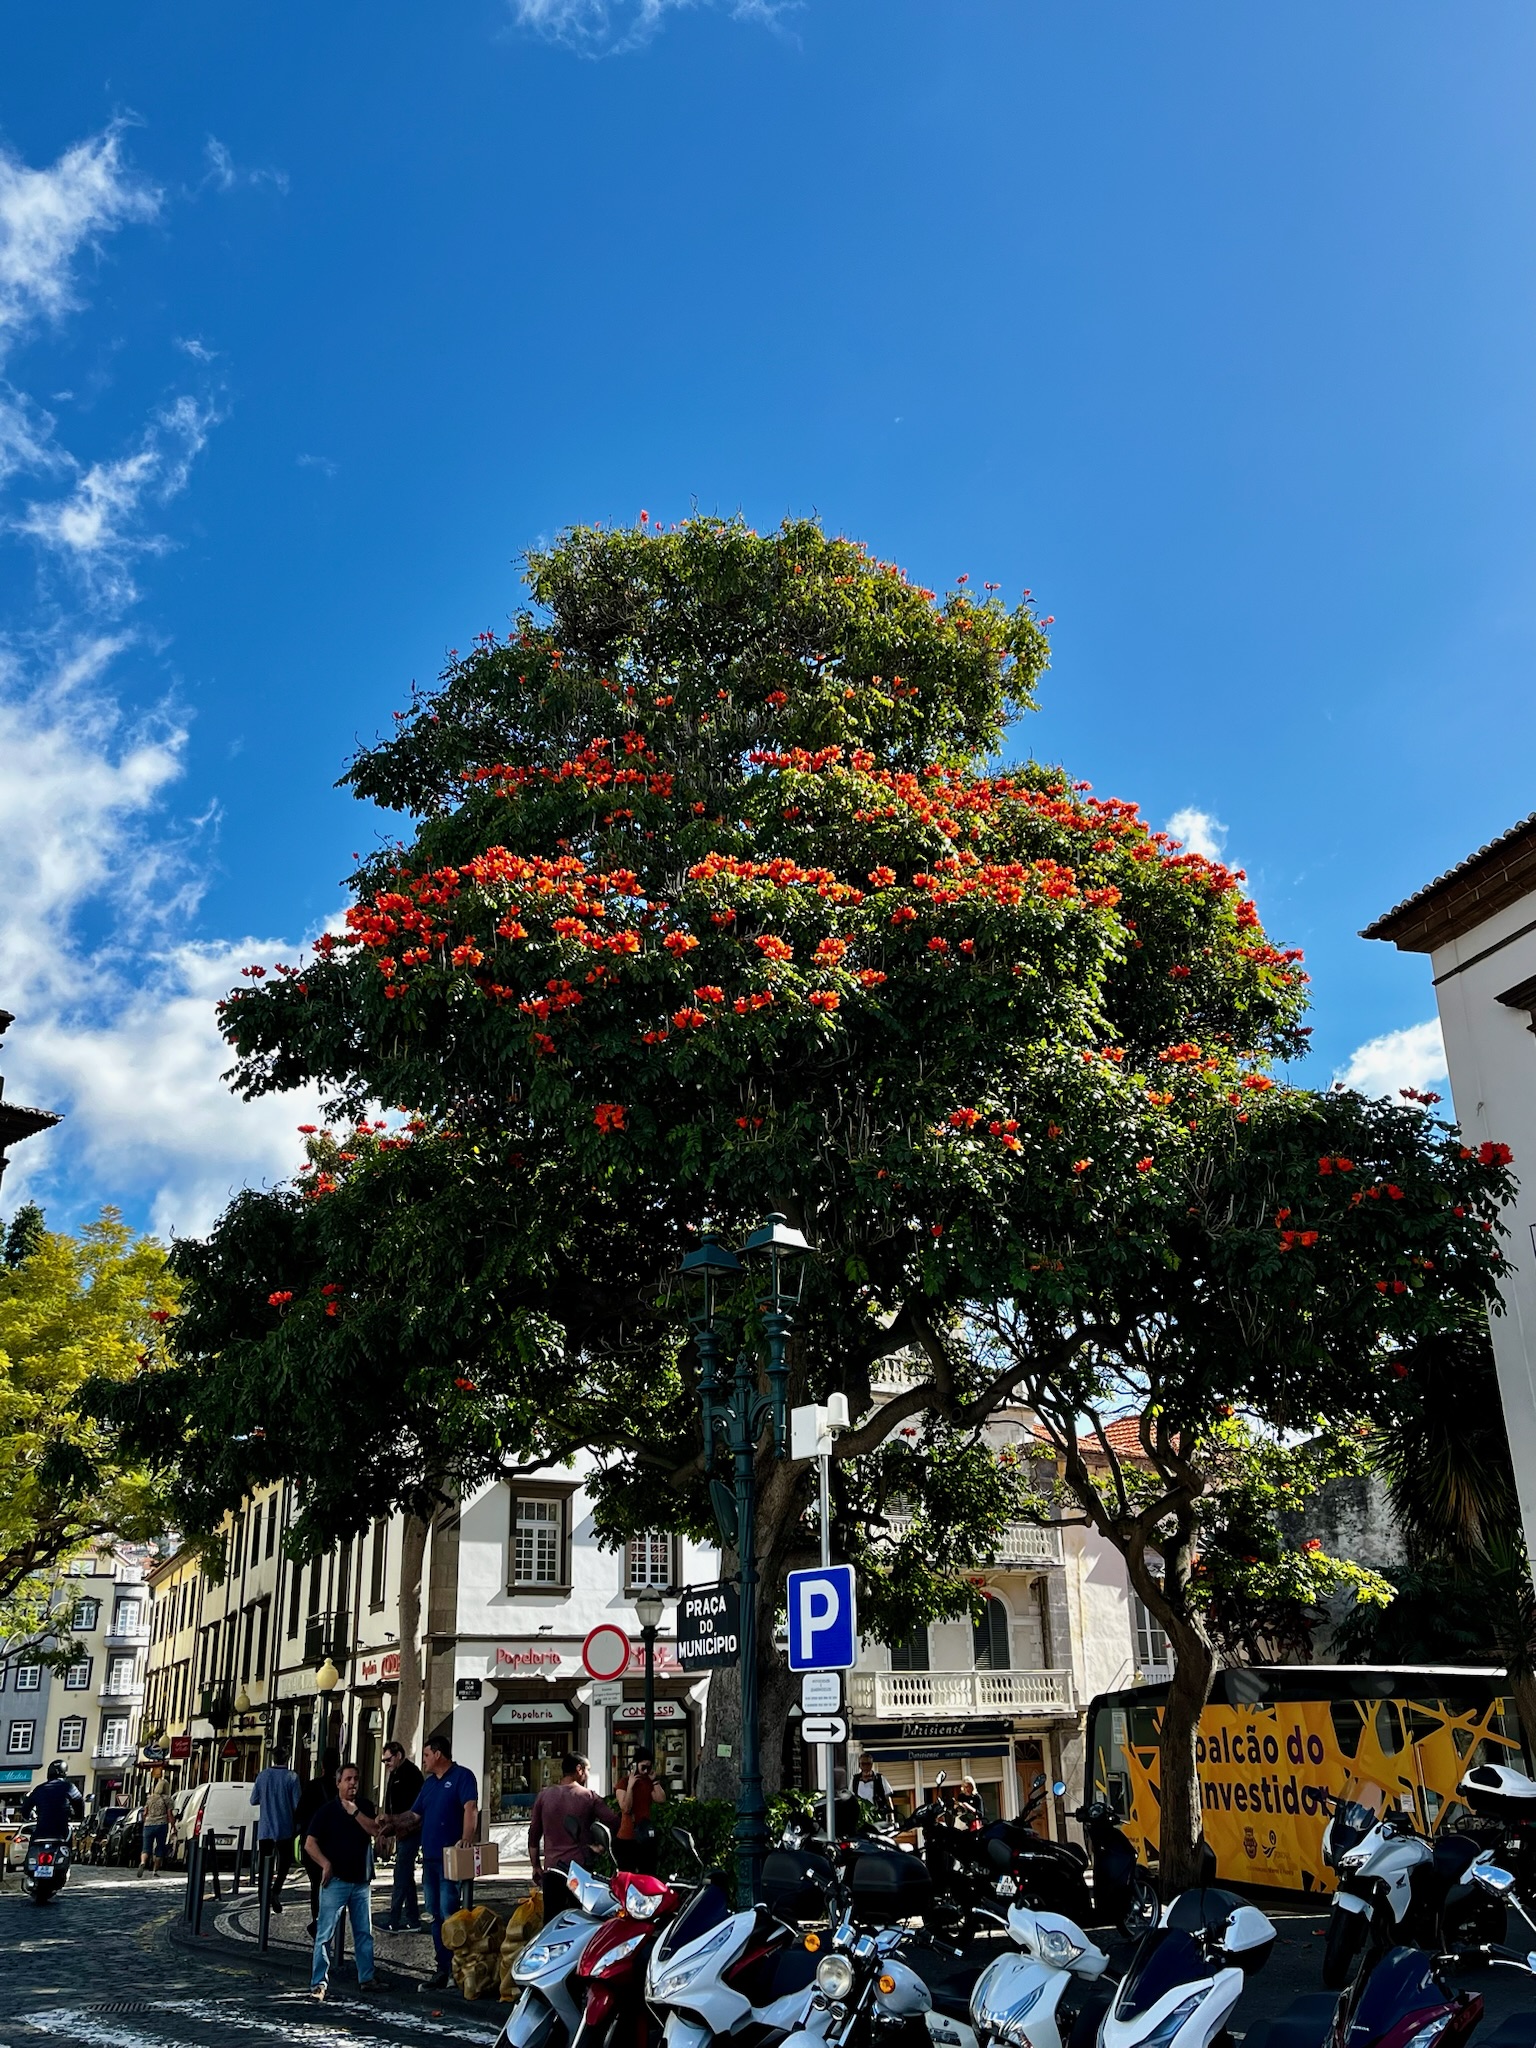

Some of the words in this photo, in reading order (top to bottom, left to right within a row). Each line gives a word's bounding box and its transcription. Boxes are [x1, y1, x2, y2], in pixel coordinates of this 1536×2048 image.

[685, 1595, 727, 1618] PRAÇA
[699, 1619, 714, 1634] DO
[800, 1579, 839, 1660] P
[678, 1632, 738, 1659] MUNICÍPIO
[496, 1647, 562, 1670] Papelaria
[511, 1708, 553, 1722] Papelaria
[622, 1706, 675, 1718] CONSSA
[1287, 1725, 1324, 1765] do
